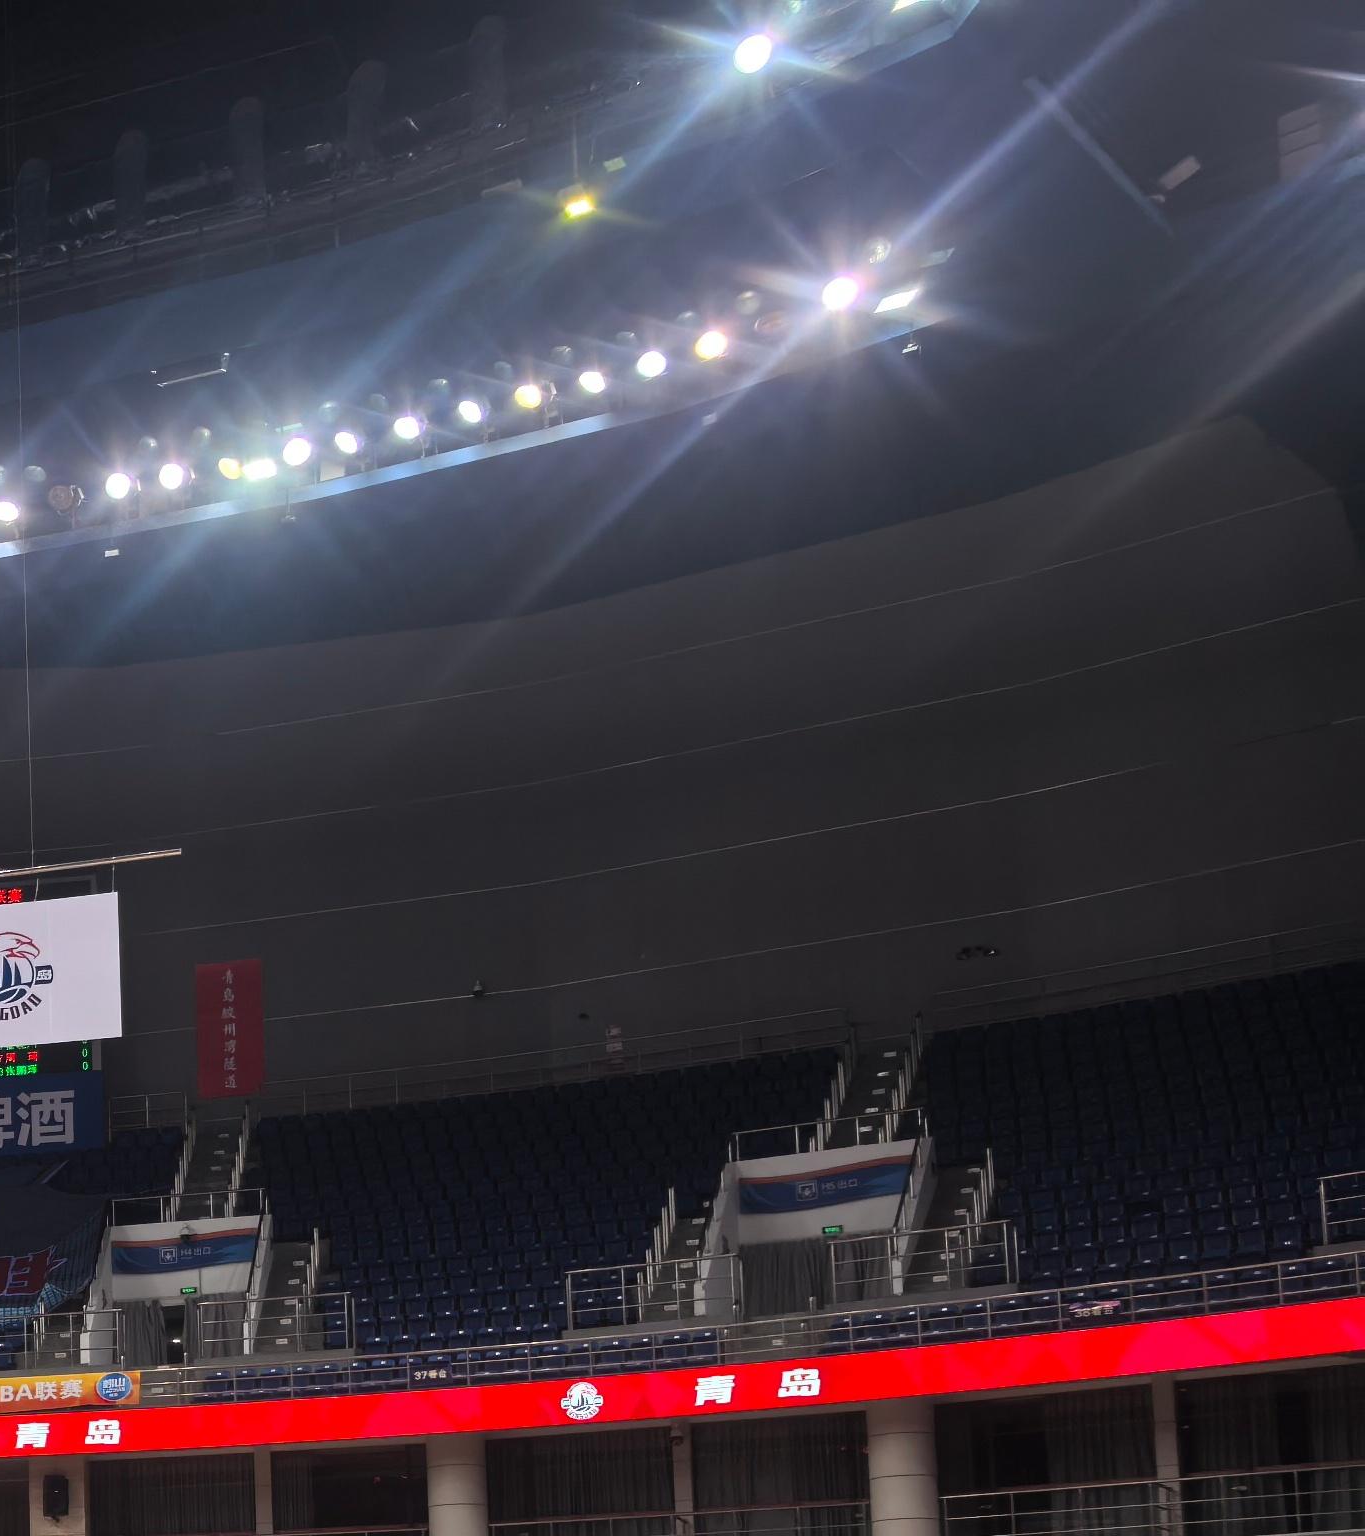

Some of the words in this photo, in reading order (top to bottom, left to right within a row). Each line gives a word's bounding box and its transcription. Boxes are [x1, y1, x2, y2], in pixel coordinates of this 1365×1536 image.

[222, 968, 237, 1088] 青岛胶州湾隧道
[695, 1368, 821, 1406] 青岛
[15, 1419, 121, 1449] 青岛
